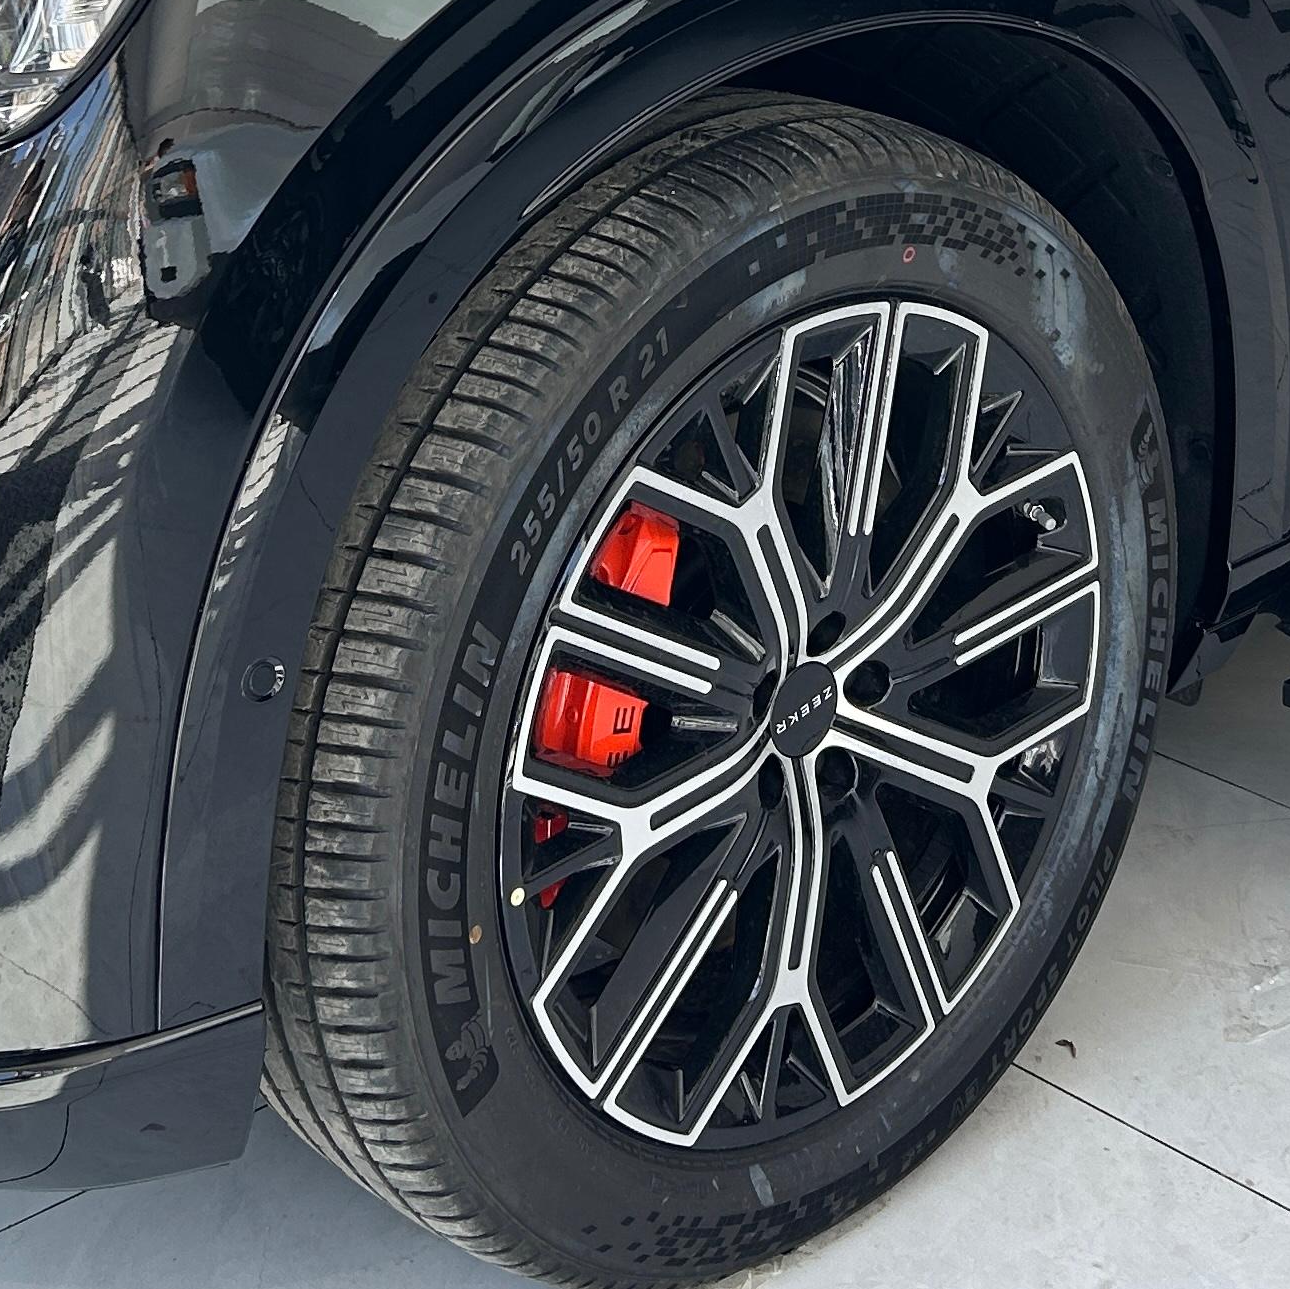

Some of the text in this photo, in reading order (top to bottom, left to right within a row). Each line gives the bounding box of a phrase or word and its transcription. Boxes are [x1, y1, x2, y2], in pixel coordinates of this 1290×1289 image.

[511, 326, 669, 576] 255/50 R 21
[775, 685, 833, 734] ZEEKR
[1120, 498, 1170, 803] MICHELIN
[426, 620, 503, 1006] MICHELIN
[1067, 845, 1115, 960] PILOT
